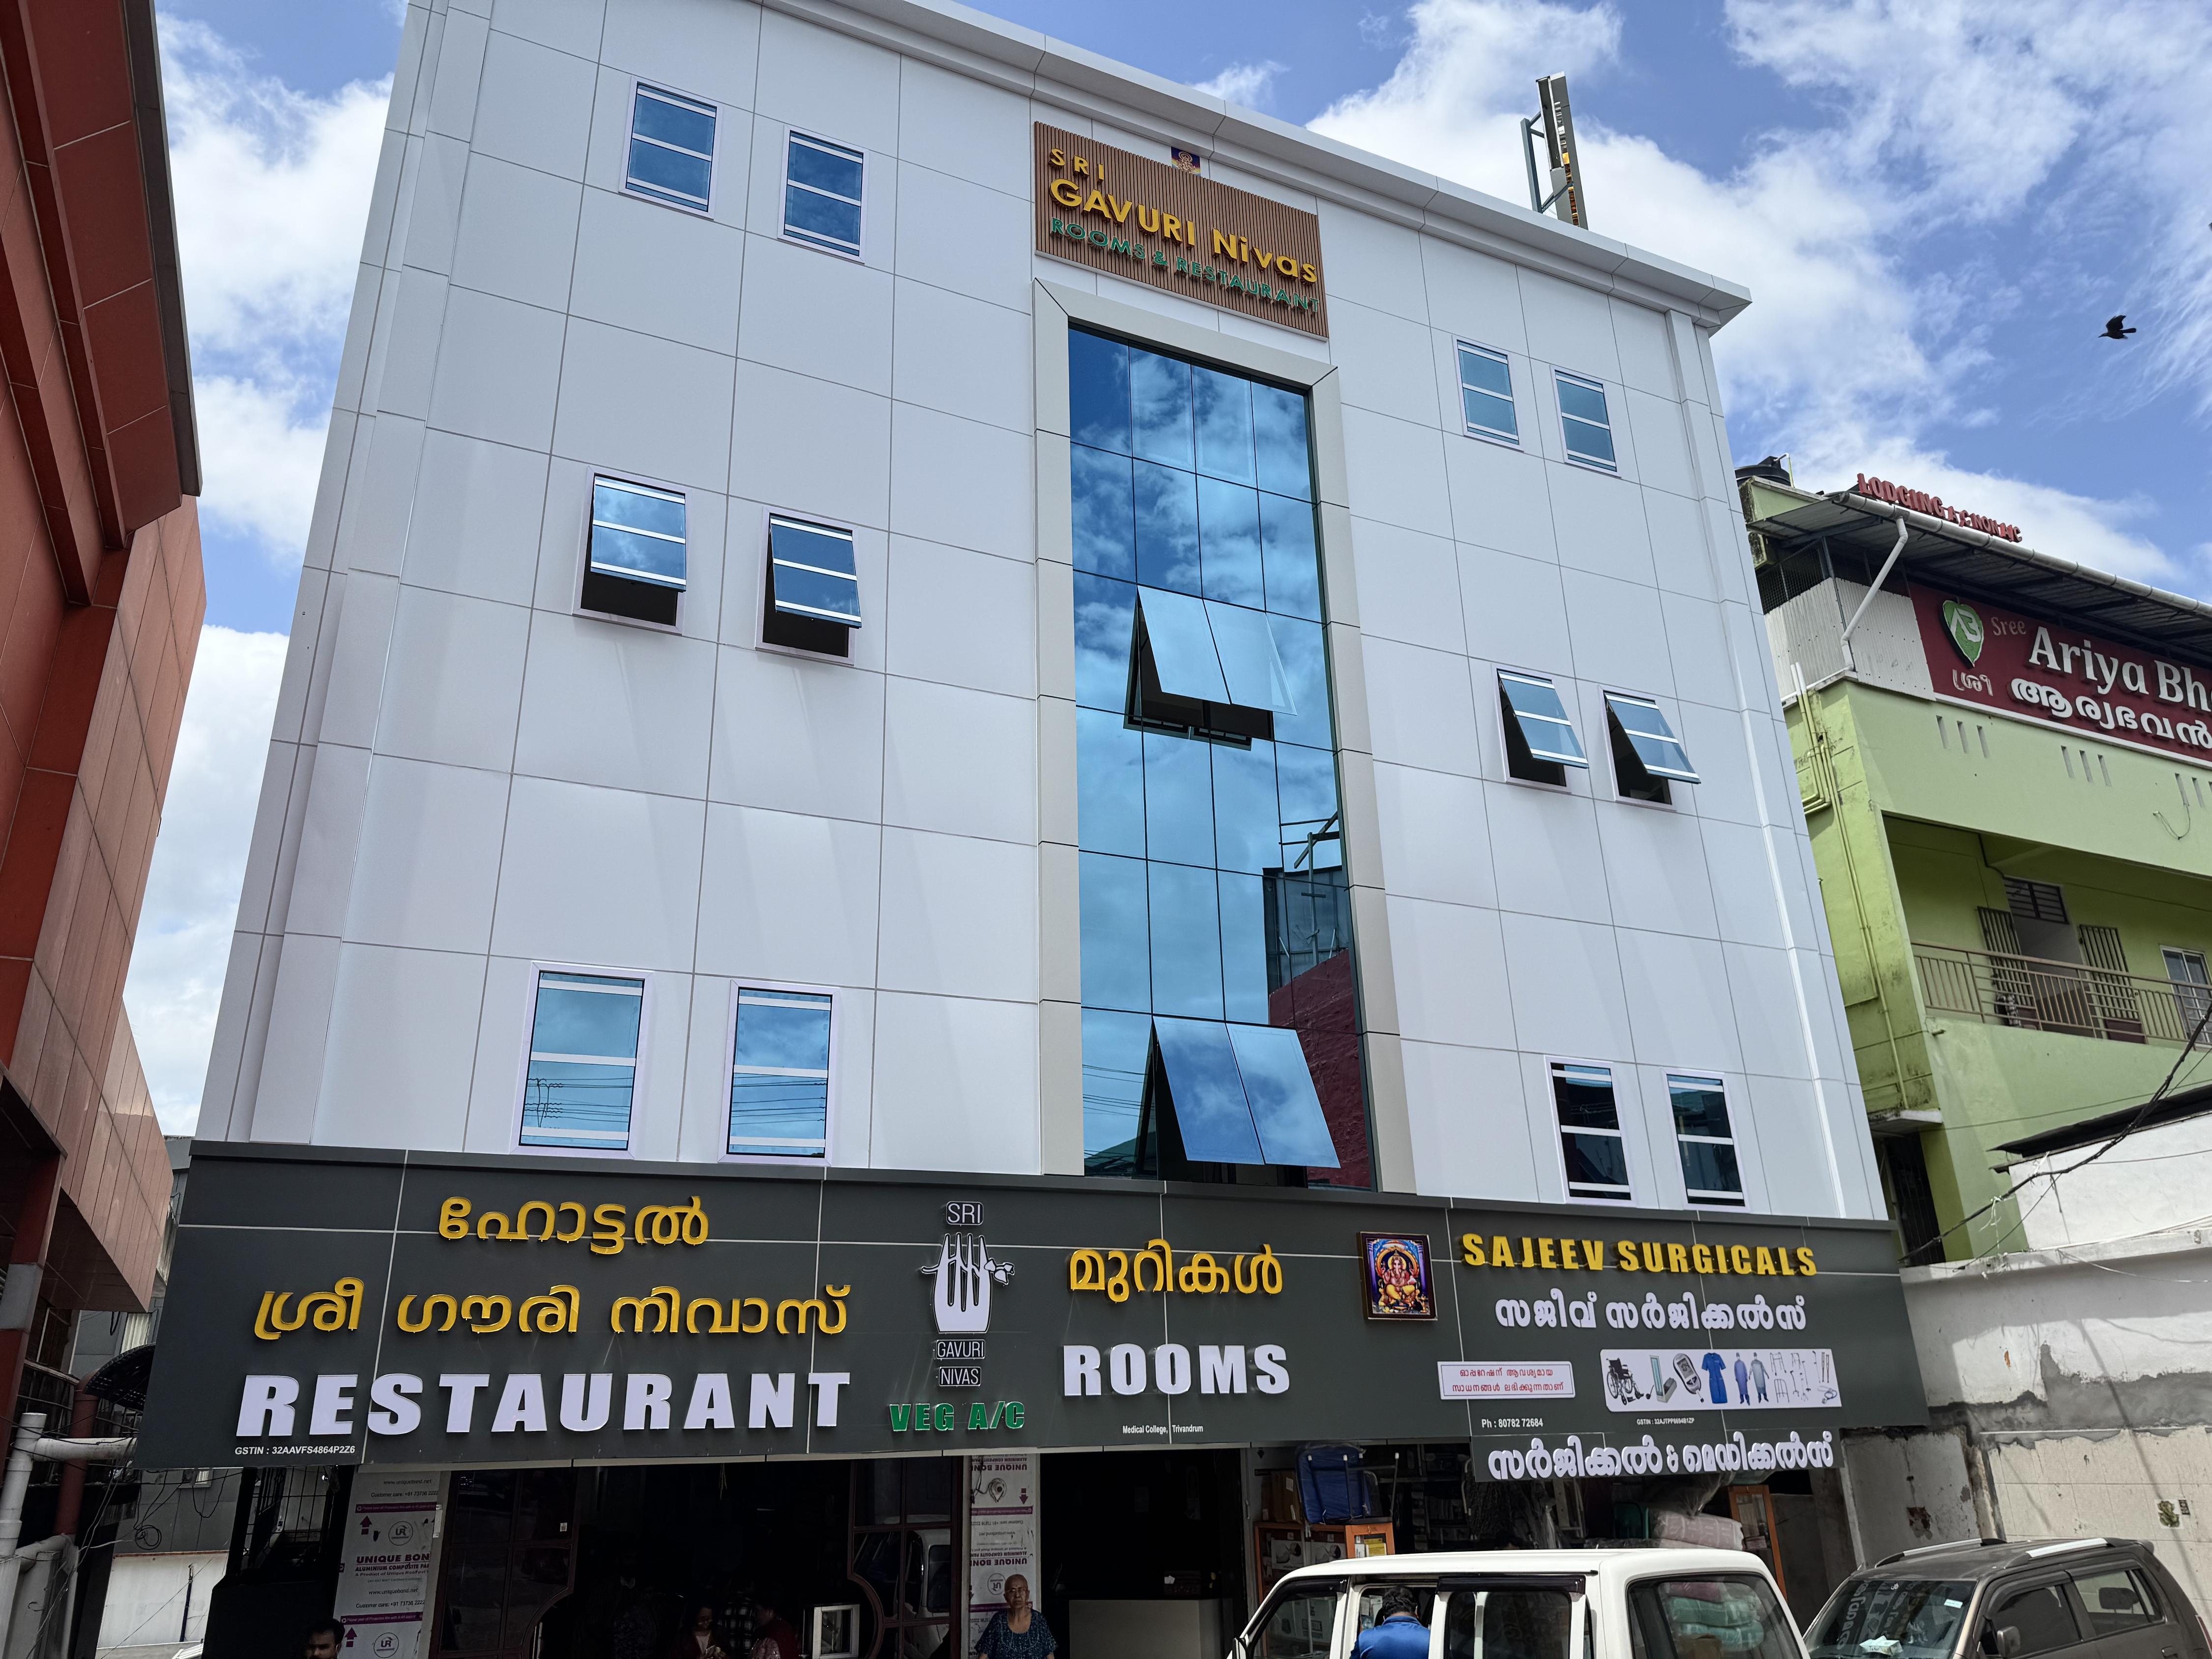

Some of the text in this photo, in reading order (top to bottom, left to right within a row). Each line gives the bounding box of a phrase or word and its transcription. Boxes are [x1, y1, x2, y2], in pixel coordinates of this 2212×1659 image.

[1049, 148, 1104, 182] SRI
[1049, 178, 1317, 284] GAVURI Nivas
[1051, 216, 1320, 314] ROOMS & RESTAURANT
[1857, 473, 1945, 517] LODGING
[1970, 513, 1999, 536] NON
[1952, 669, 1994, 697] ശ്രീ
[1991, 616, 2212, 713] Sree Ariya Bh
[438, 1196, 709, 1254] ഹോട്ടൽ
[947, 1203, 982, 1223] SRI
[1070, 1238, 1283, 1303] മുറികൾ
[1461, 1233, 1817, 1277] SAJEEV SURGICALS
[254, 1277, 851, 1340] ശ്രീ ഗൗരി നിവാസ്
[1495, 1288, 1807, 1331] സജീവ് സർജിക്കൽസ്
[936, 1341, 984, 1358] GAVURI
[940, 1368, 980, 1385] NIVAS
[1063, 1343, 1290, 1396] ROOMS
[1453, 1383, 1500, 1392] സാധനങ്ങൾ
[1507, 1368, 1553, 1378] ആവശ്യമായ
[236, 1372, 850, 1437] RESTAURANT
[890, 1400, 1026, 1432] VEG A/C
[1482, 1419, 1492, 1428] Ph
[1498, 1418, 1520, 1427] 80782
[1521, 1418, 1543, 1427] 72684
[1122, 1424, 1203, 1435] Medical College, Trivandrum
[235, 1447, 264, 1455] GSTIN
[272, 1446, 355, 1454] 32AAVFS4864P2Z6
[1488, 1430, 1834, 1481] സർജിക്കൽ & മെഡിക്കൽസ്
[356, 1553, 431, 1564] UNIQUE BON
